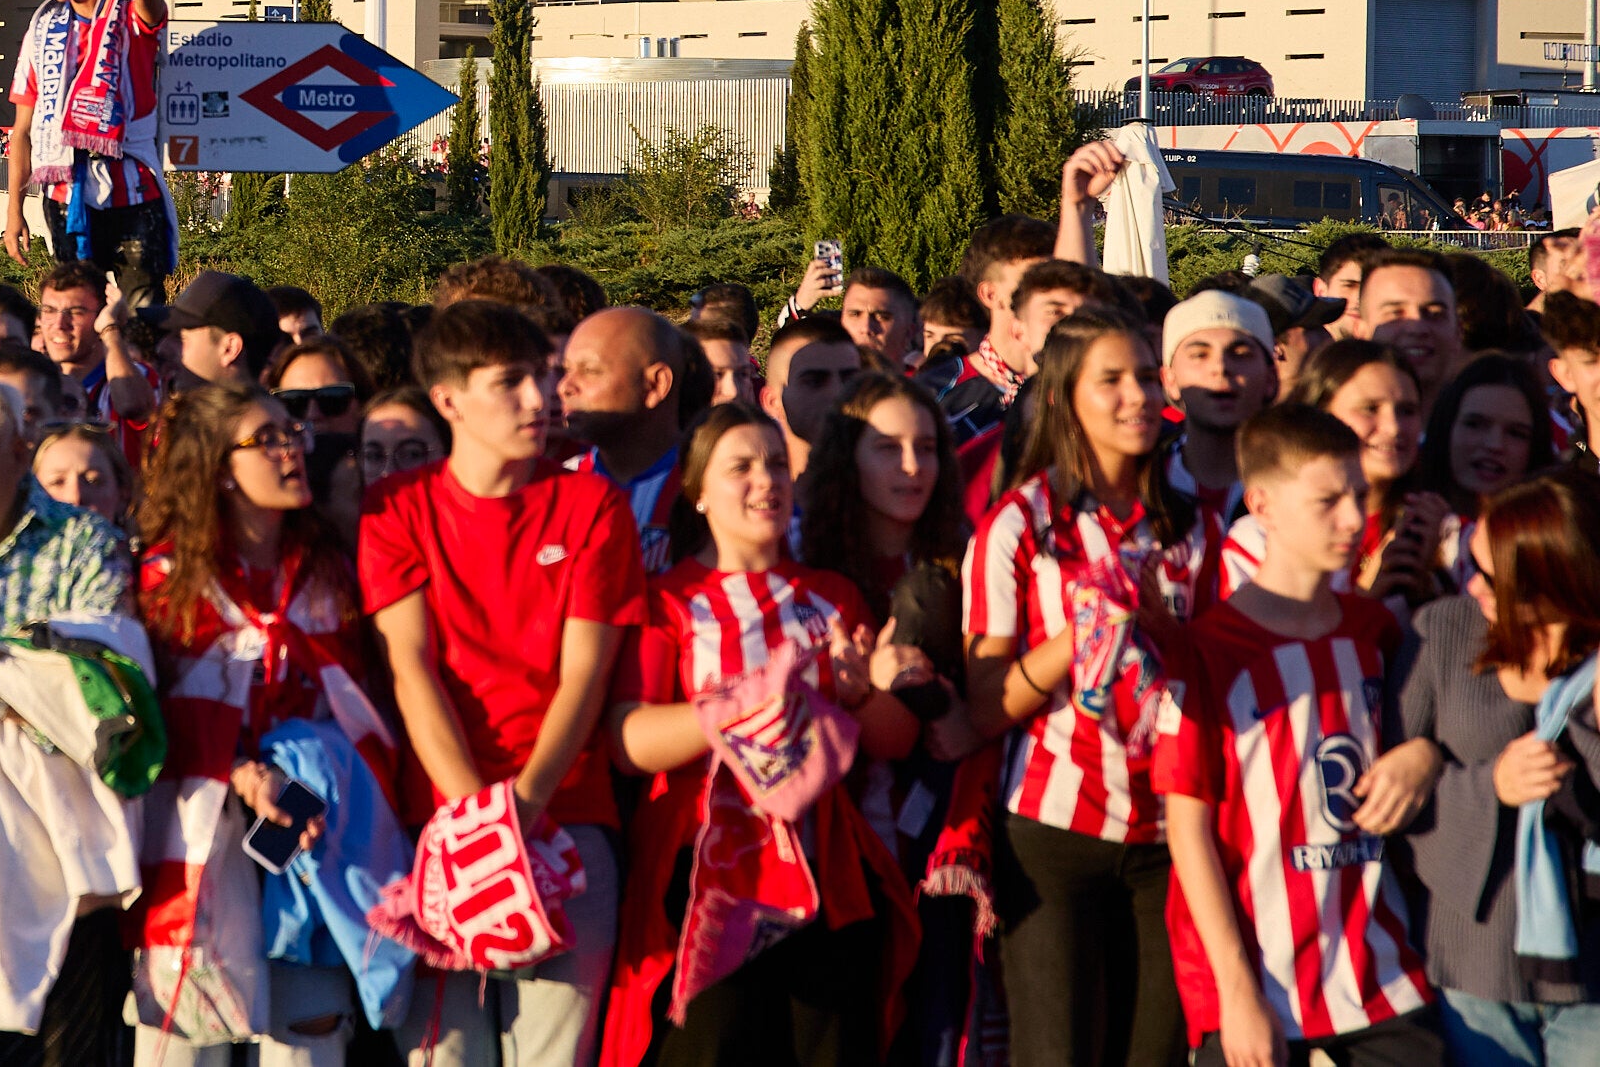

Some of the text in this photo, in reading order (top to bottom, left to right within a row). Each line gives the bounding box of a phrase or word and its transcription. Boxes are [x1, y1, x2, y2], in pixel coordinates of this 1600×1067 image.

[170, 32, 233, 47] Estadio
[169, 53, 287, 70] Metropolitano
[300, 90, 355, 107] Metro
[176, 139, 194, 162] 7
